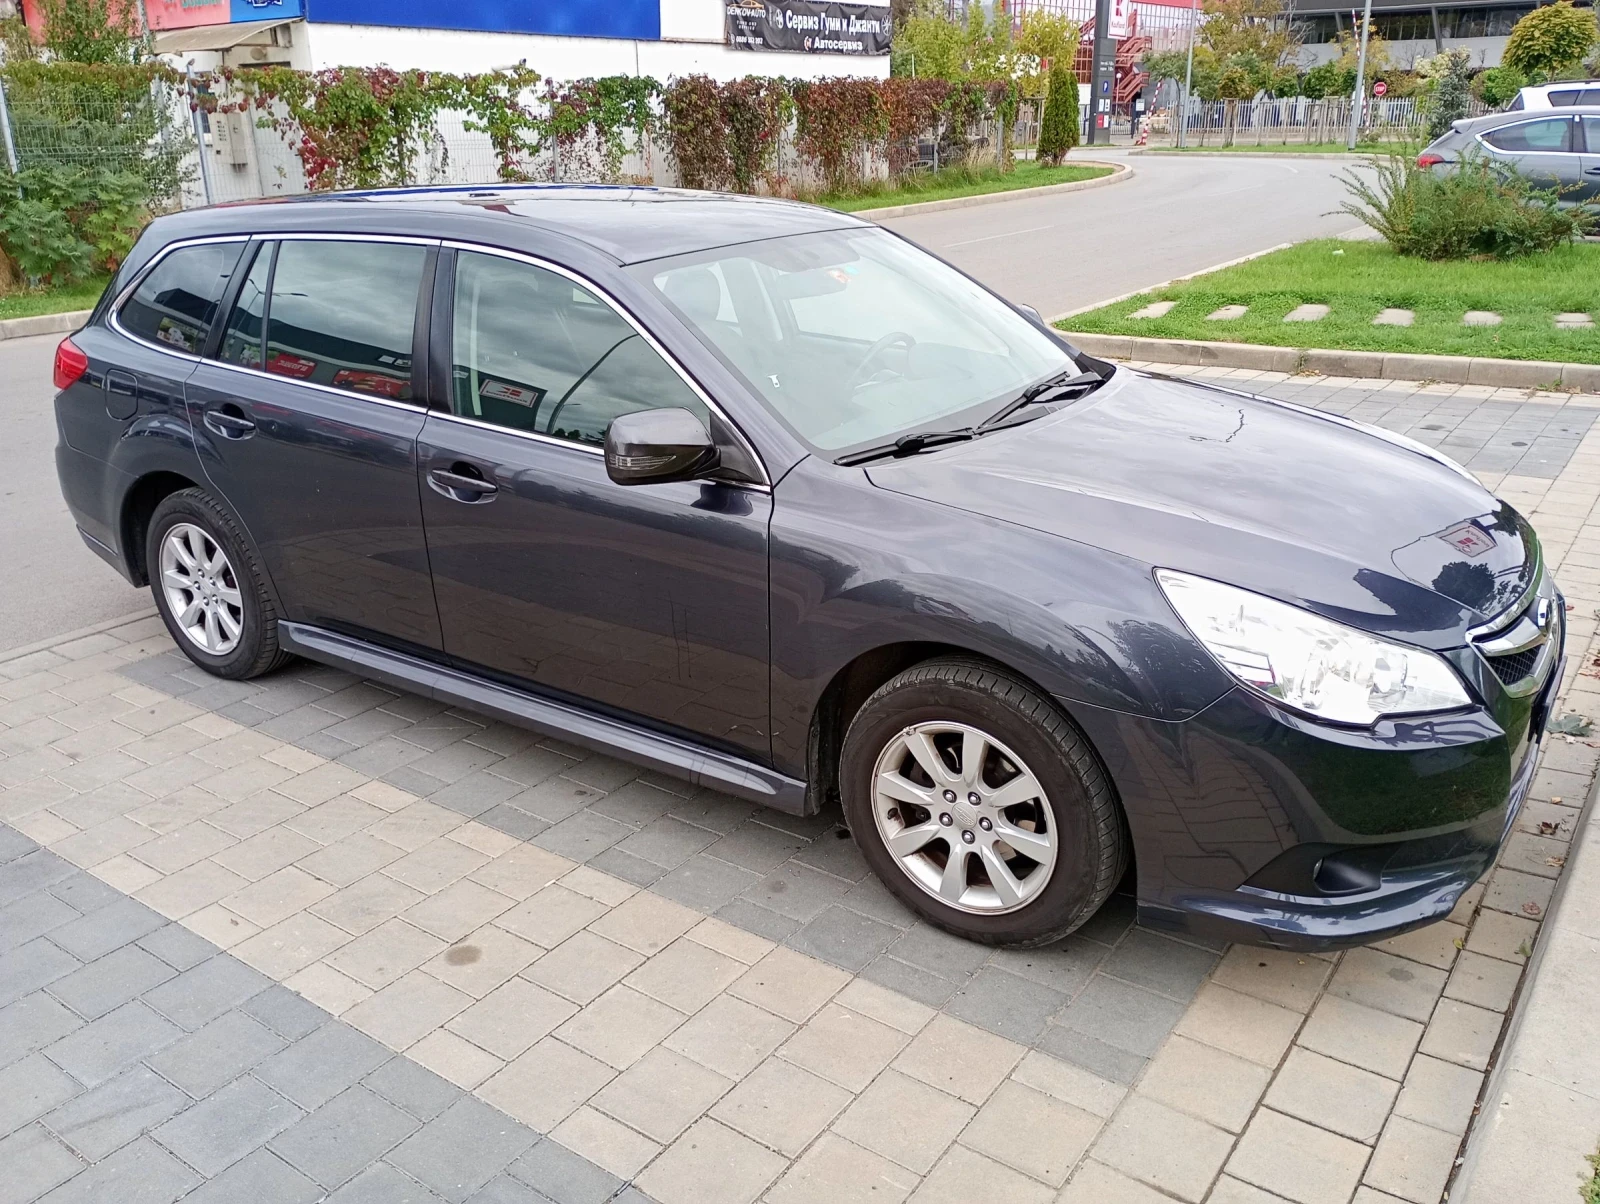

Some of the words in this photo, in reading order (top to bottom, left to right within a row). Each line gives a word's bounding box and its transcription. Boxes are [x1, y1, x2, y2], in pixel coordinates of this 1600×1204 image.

[785, 9, 819, 33] Сервиз
[820, 12, 841, 35] Гуми
[842, 18, 848, 32] и
[848, 14, 880, 36] Джанти
[813, 36, 863, 52] Автосервиз
